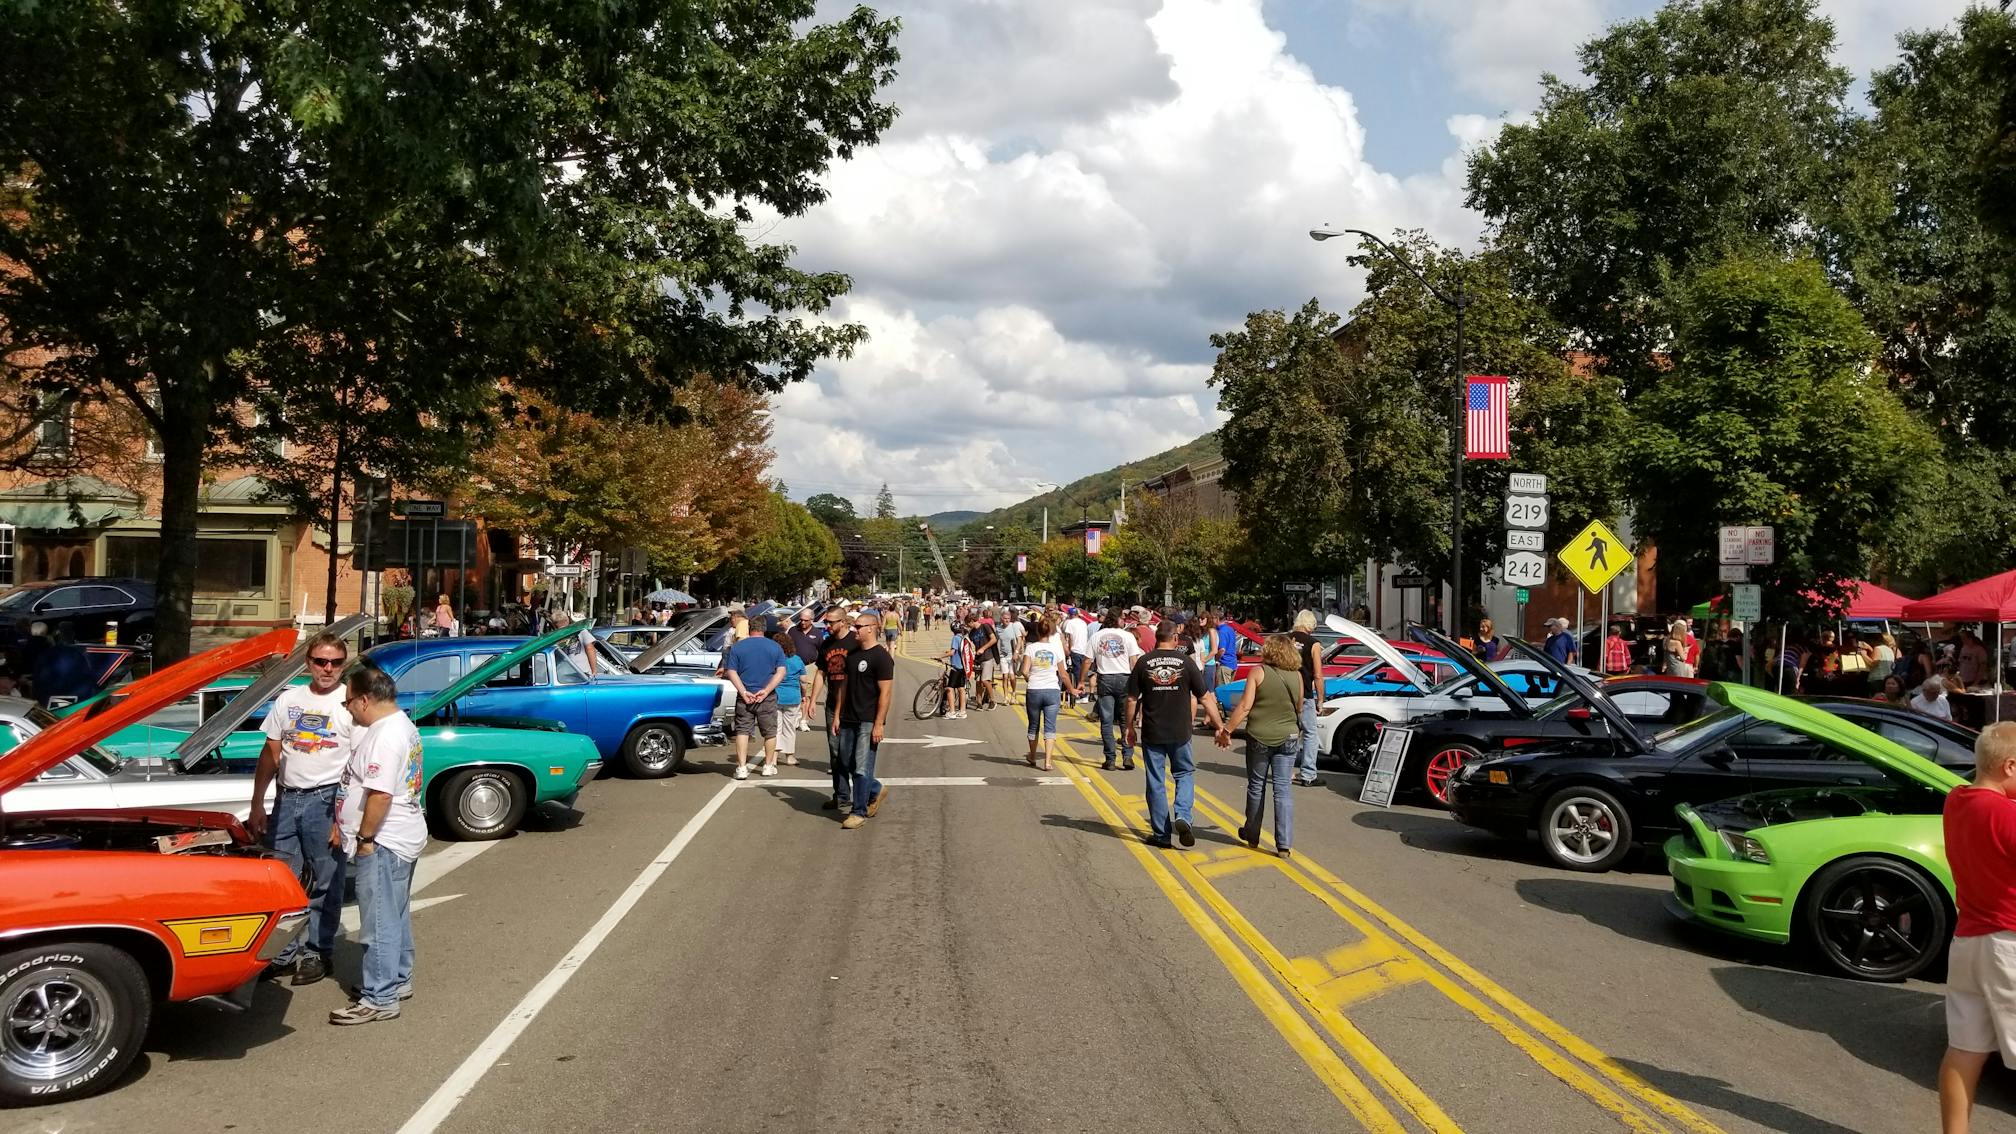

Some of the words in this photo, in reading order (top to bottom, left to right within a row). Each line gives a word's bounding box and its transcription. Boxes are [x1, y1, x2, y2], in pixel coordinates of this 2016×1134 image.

[1513, 478, 1542, 489] NORTH
[1512, 503, 1541, 520] 219
[1510, 535, 1541, 546] EAST
[1508, 560, 1542, 578] 242
[472, 773, 500, 781] Radial
[66, 1047, 118, 1089] Radial
[31, 1084, 61, 1094] T/A
